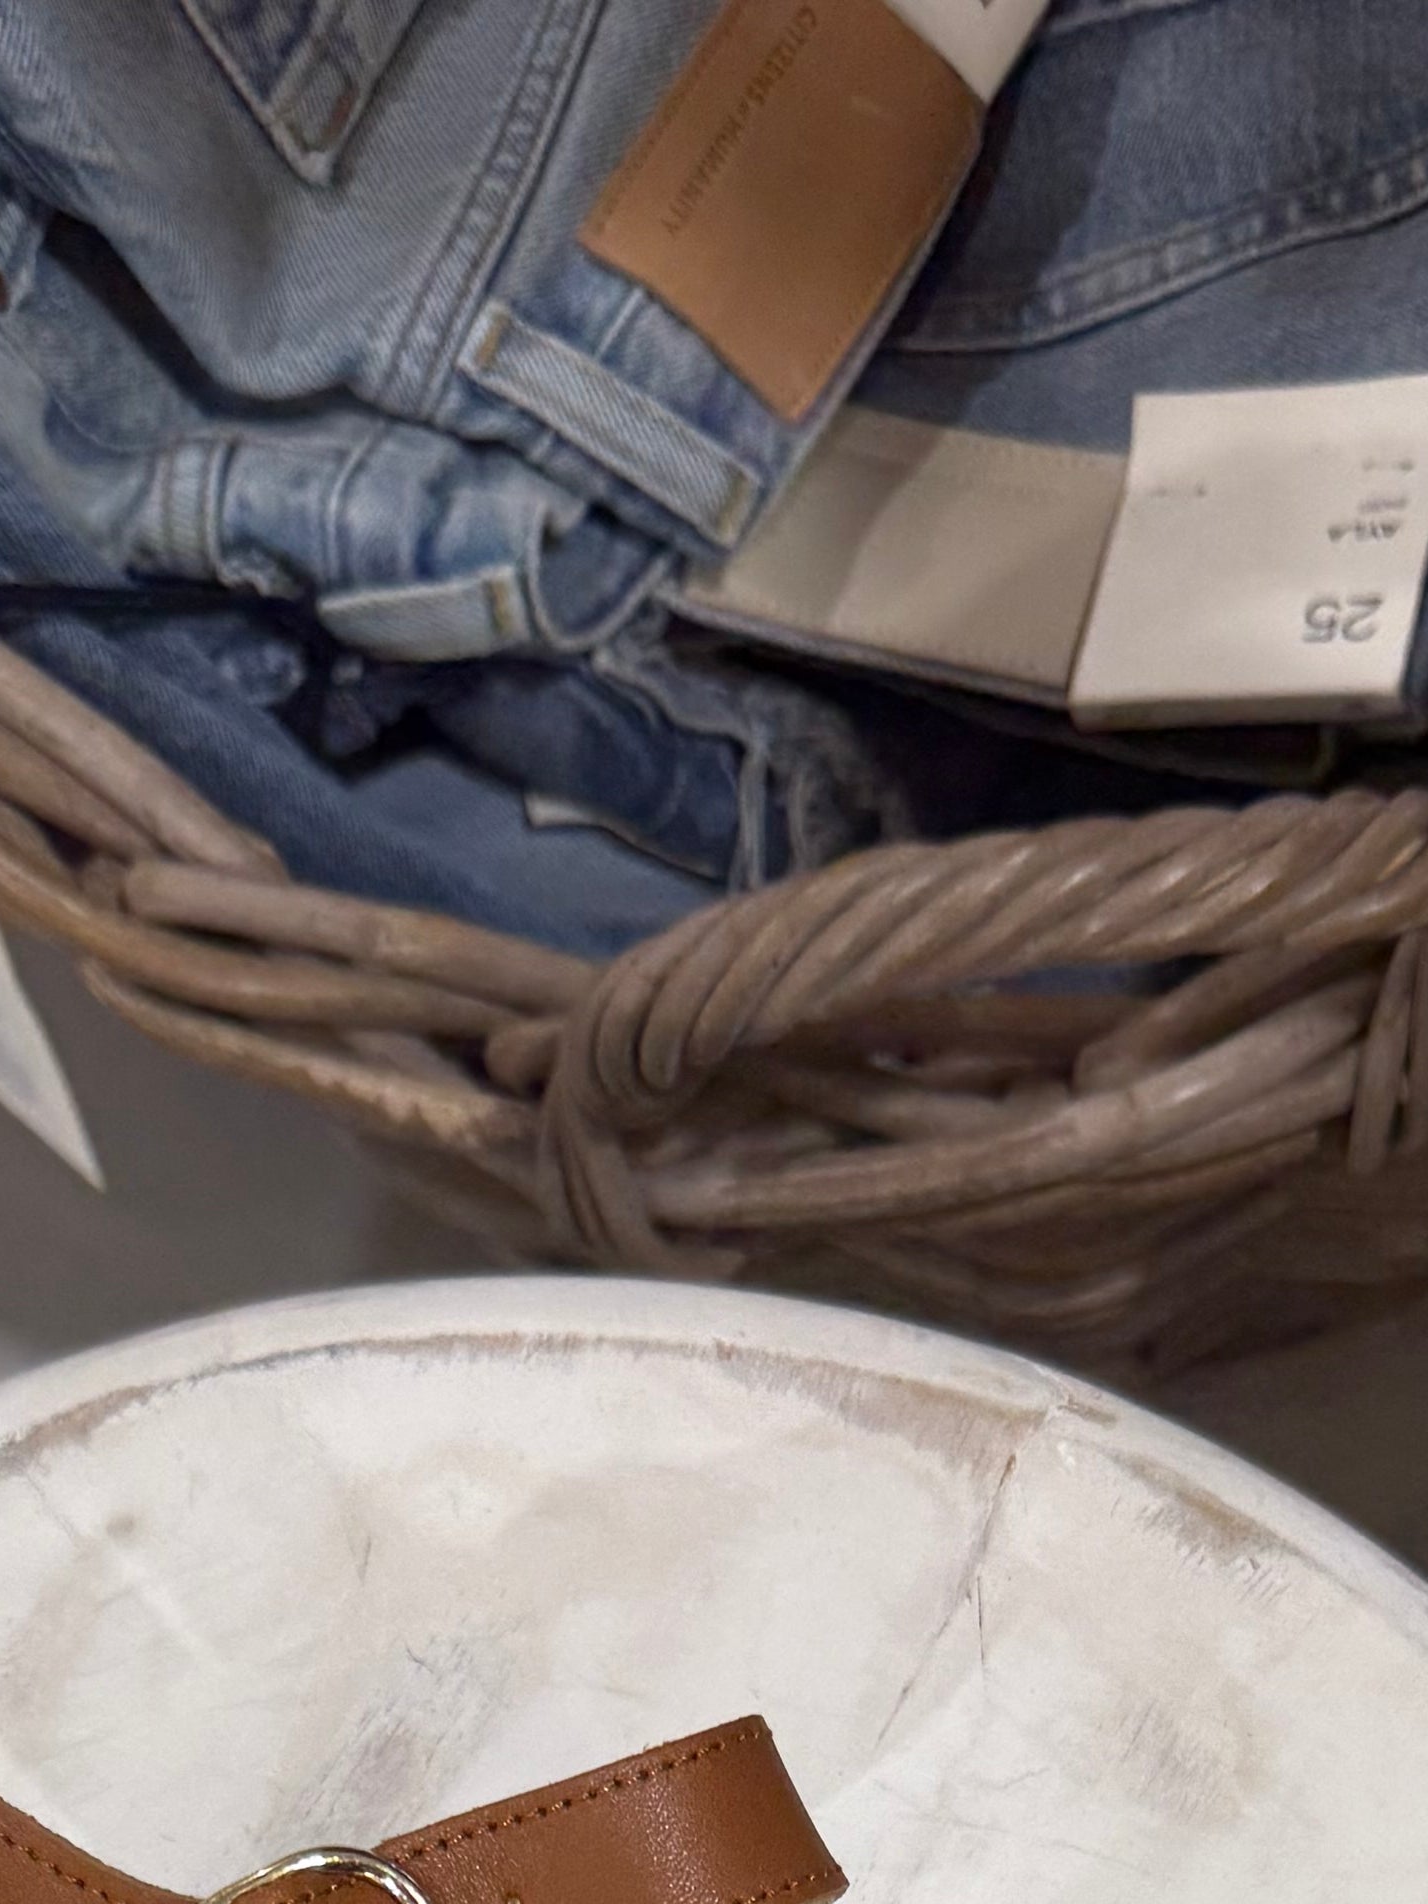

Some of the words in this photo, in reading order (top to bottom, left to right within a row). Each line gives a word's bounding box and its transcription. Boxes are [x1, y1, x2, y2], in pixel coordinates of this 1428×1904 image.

[745, 6, 817, 107] CITIZENS
[660, 114, 746, 239] HUMANITY
[1302, 593, 1384, 643] 25
